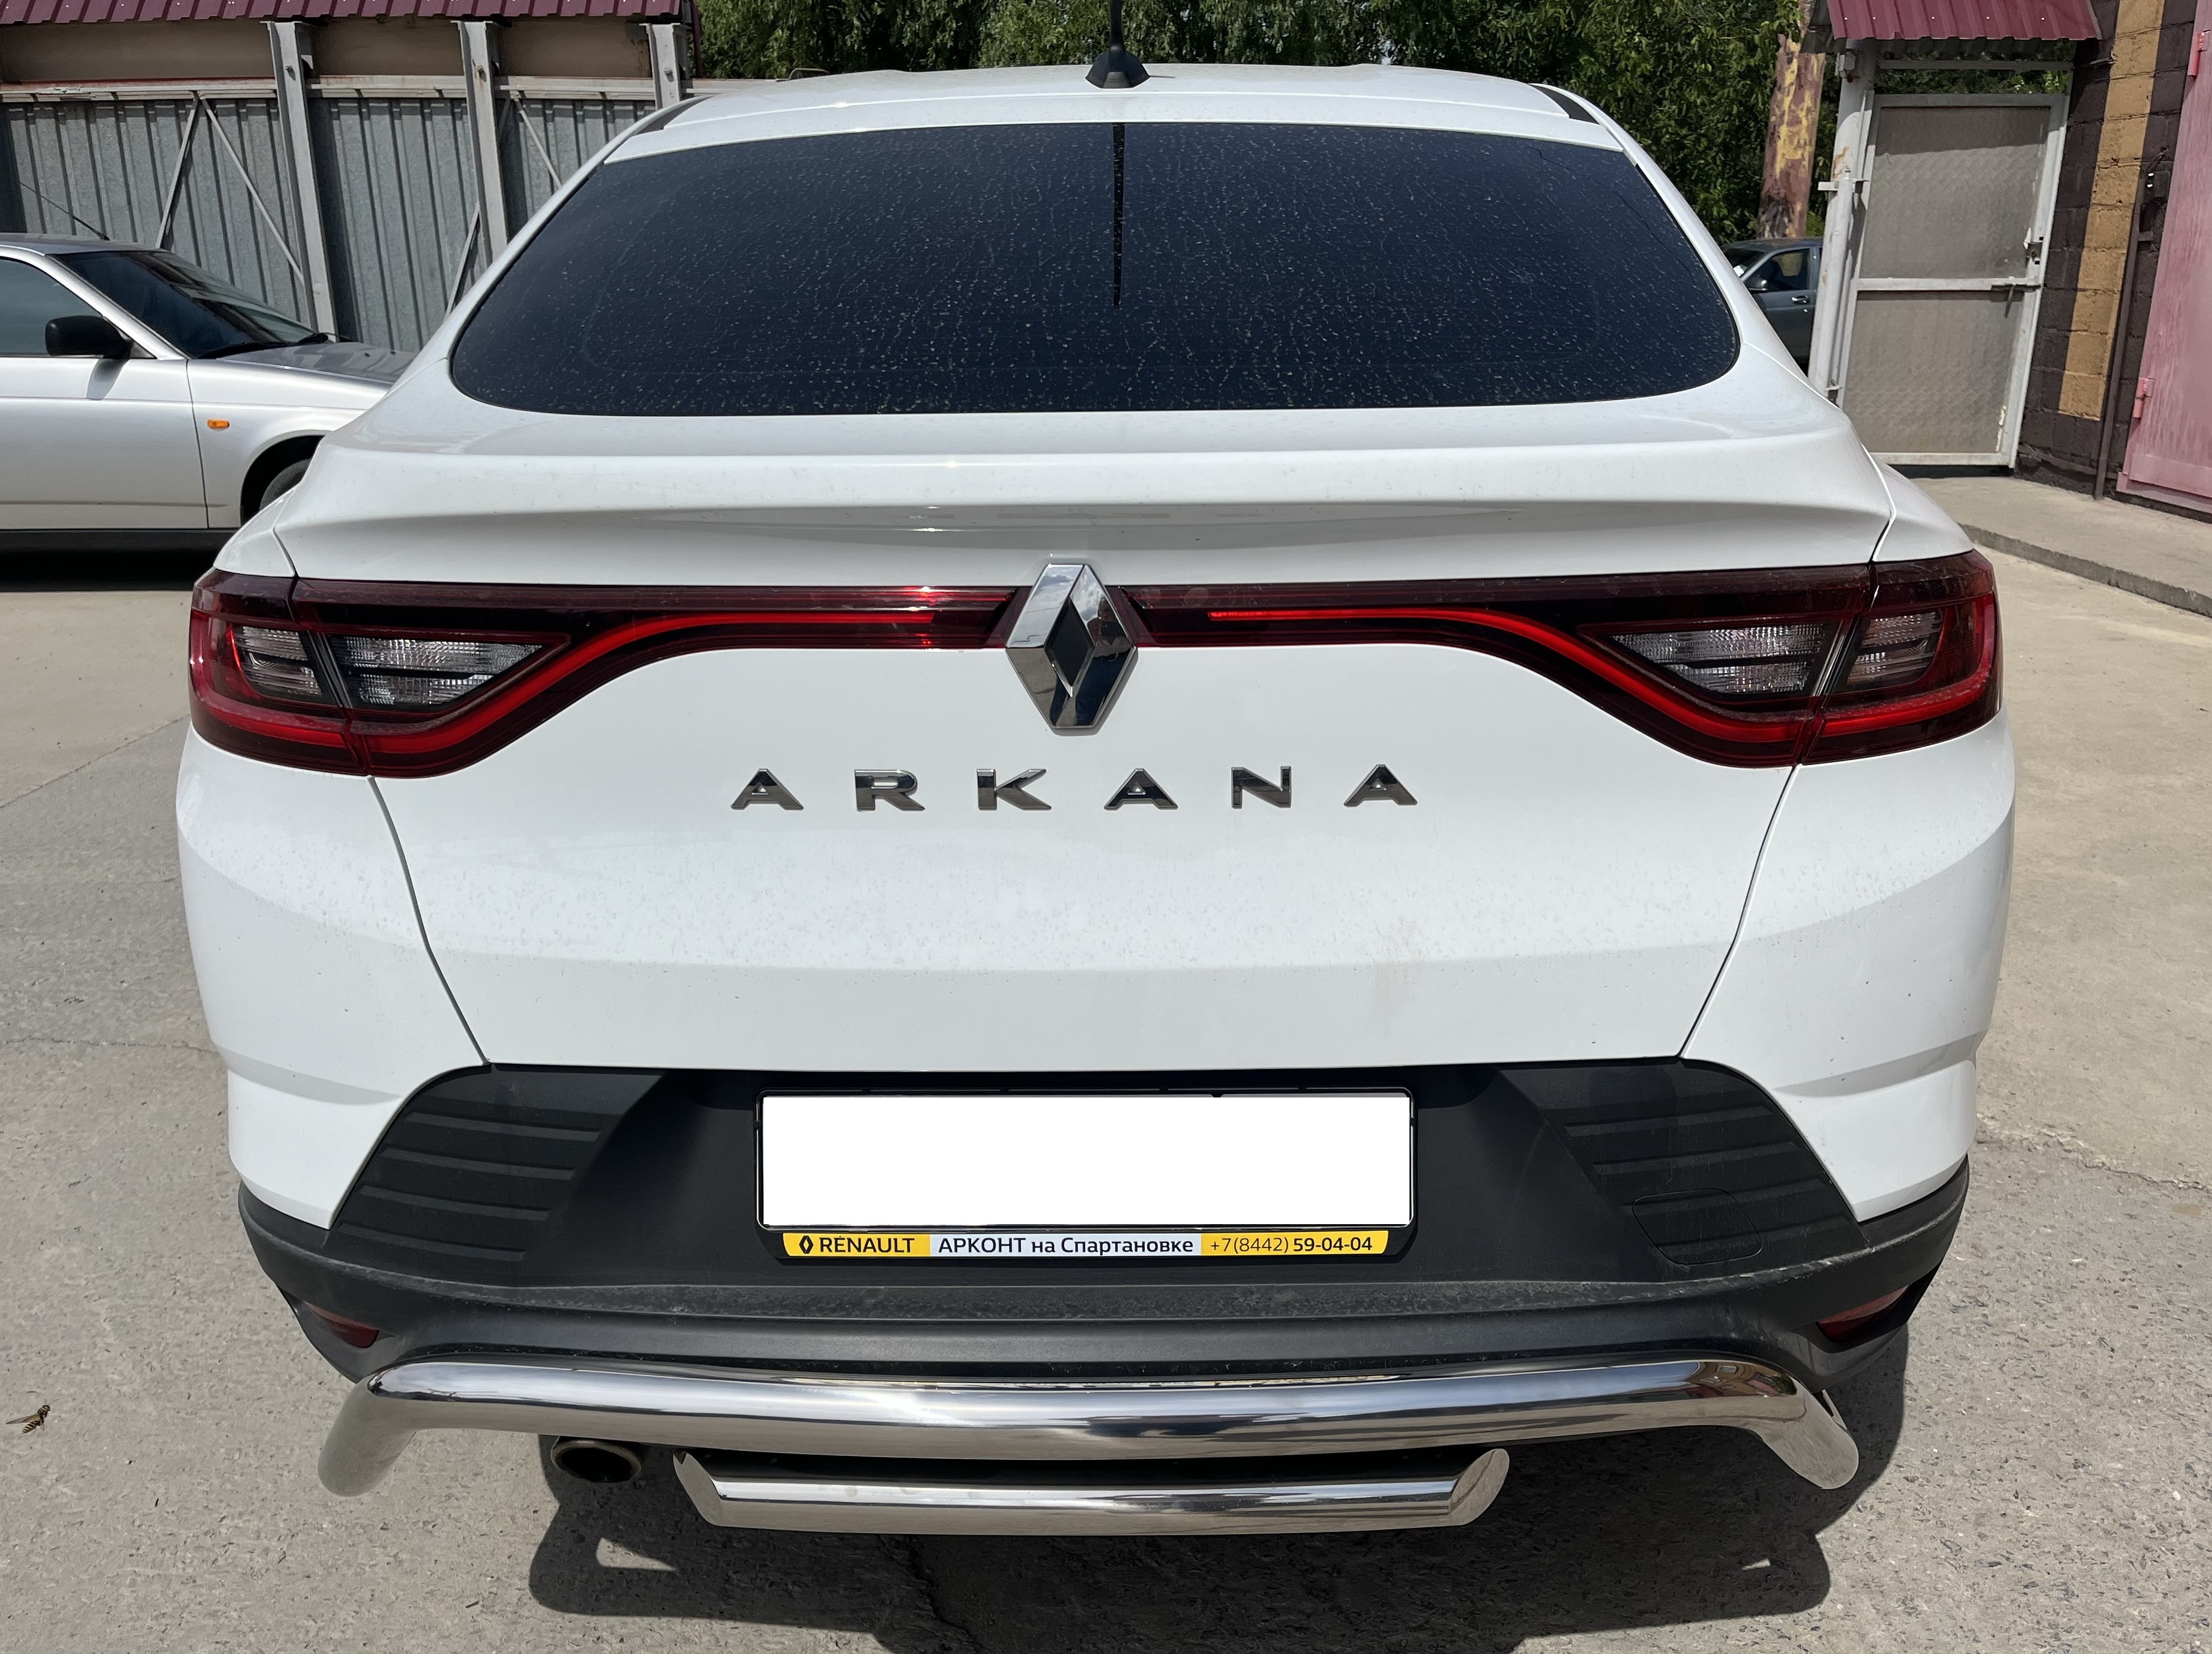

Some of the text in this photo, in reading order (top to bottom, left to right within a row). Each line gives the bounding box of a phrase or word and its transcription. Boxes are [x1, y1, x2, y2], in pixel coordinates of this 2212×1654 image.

[730, 764, 1419, 812] ARKANA
[819, 1237, 915, 1254] RENAULT
[938, 1236, 1373, 1256] АРКОНТ на Спартановке +7(8442) 59-04-04
